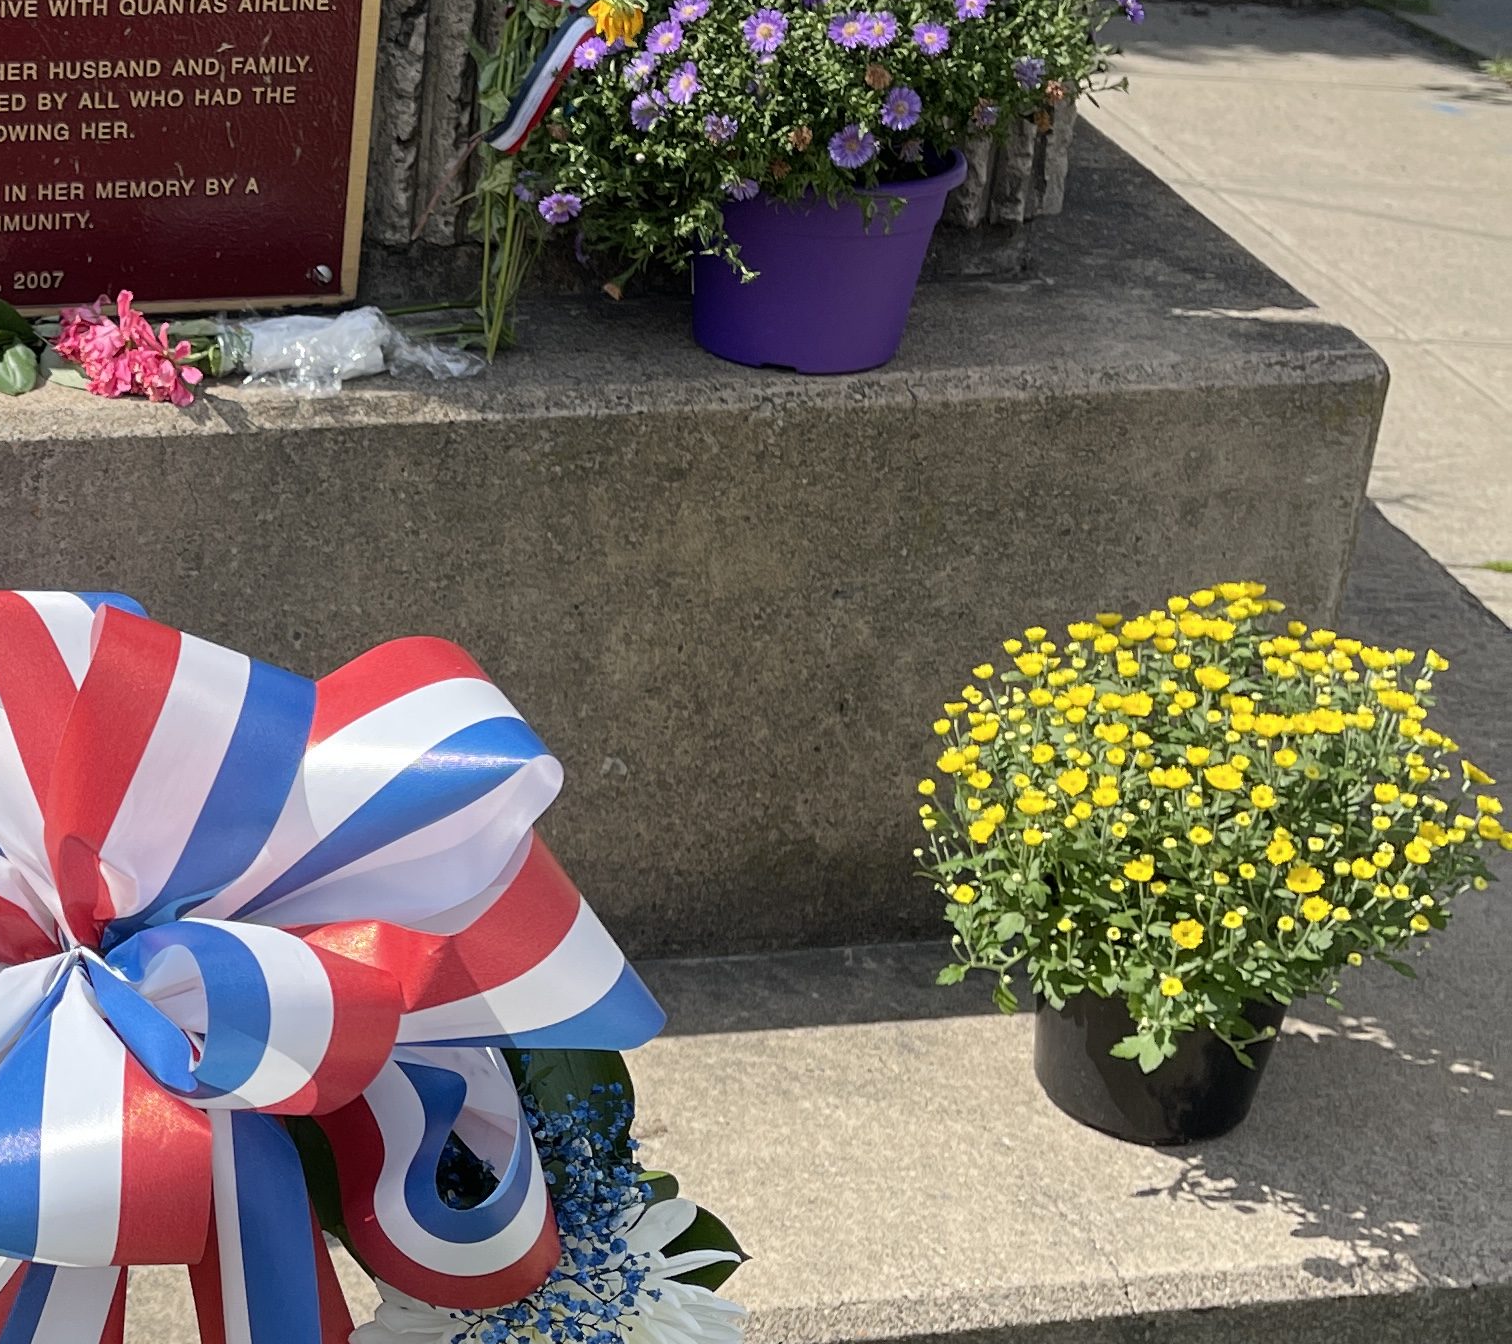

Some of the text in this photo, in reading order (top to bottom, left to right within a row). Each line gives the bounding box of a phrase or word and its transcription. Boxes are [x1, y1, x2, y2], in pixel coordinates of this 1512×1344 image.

[49, 59, 162, 80] HUSBAND
[171, 58, 222, 78] AND
[231, 55, 313, 76] FAMILY.
[37, 92, 68, 110] BY
[77, 91, 120, 109] ALL
[129, 89, 184, 108] WHO
[194, 87, 242, 106] HAD
[251, 84, 297, 104] THE
[81, 121, 135, 140] HER.
[4, 184, 27, 202] IN
[37, 182, 85, 201] HER
[95, 178, 195, 199] MEMORY
[205, 178, 235, 196] BY
[244, 177, 259, 194] A
[13, 271, 65, 290] 2007
